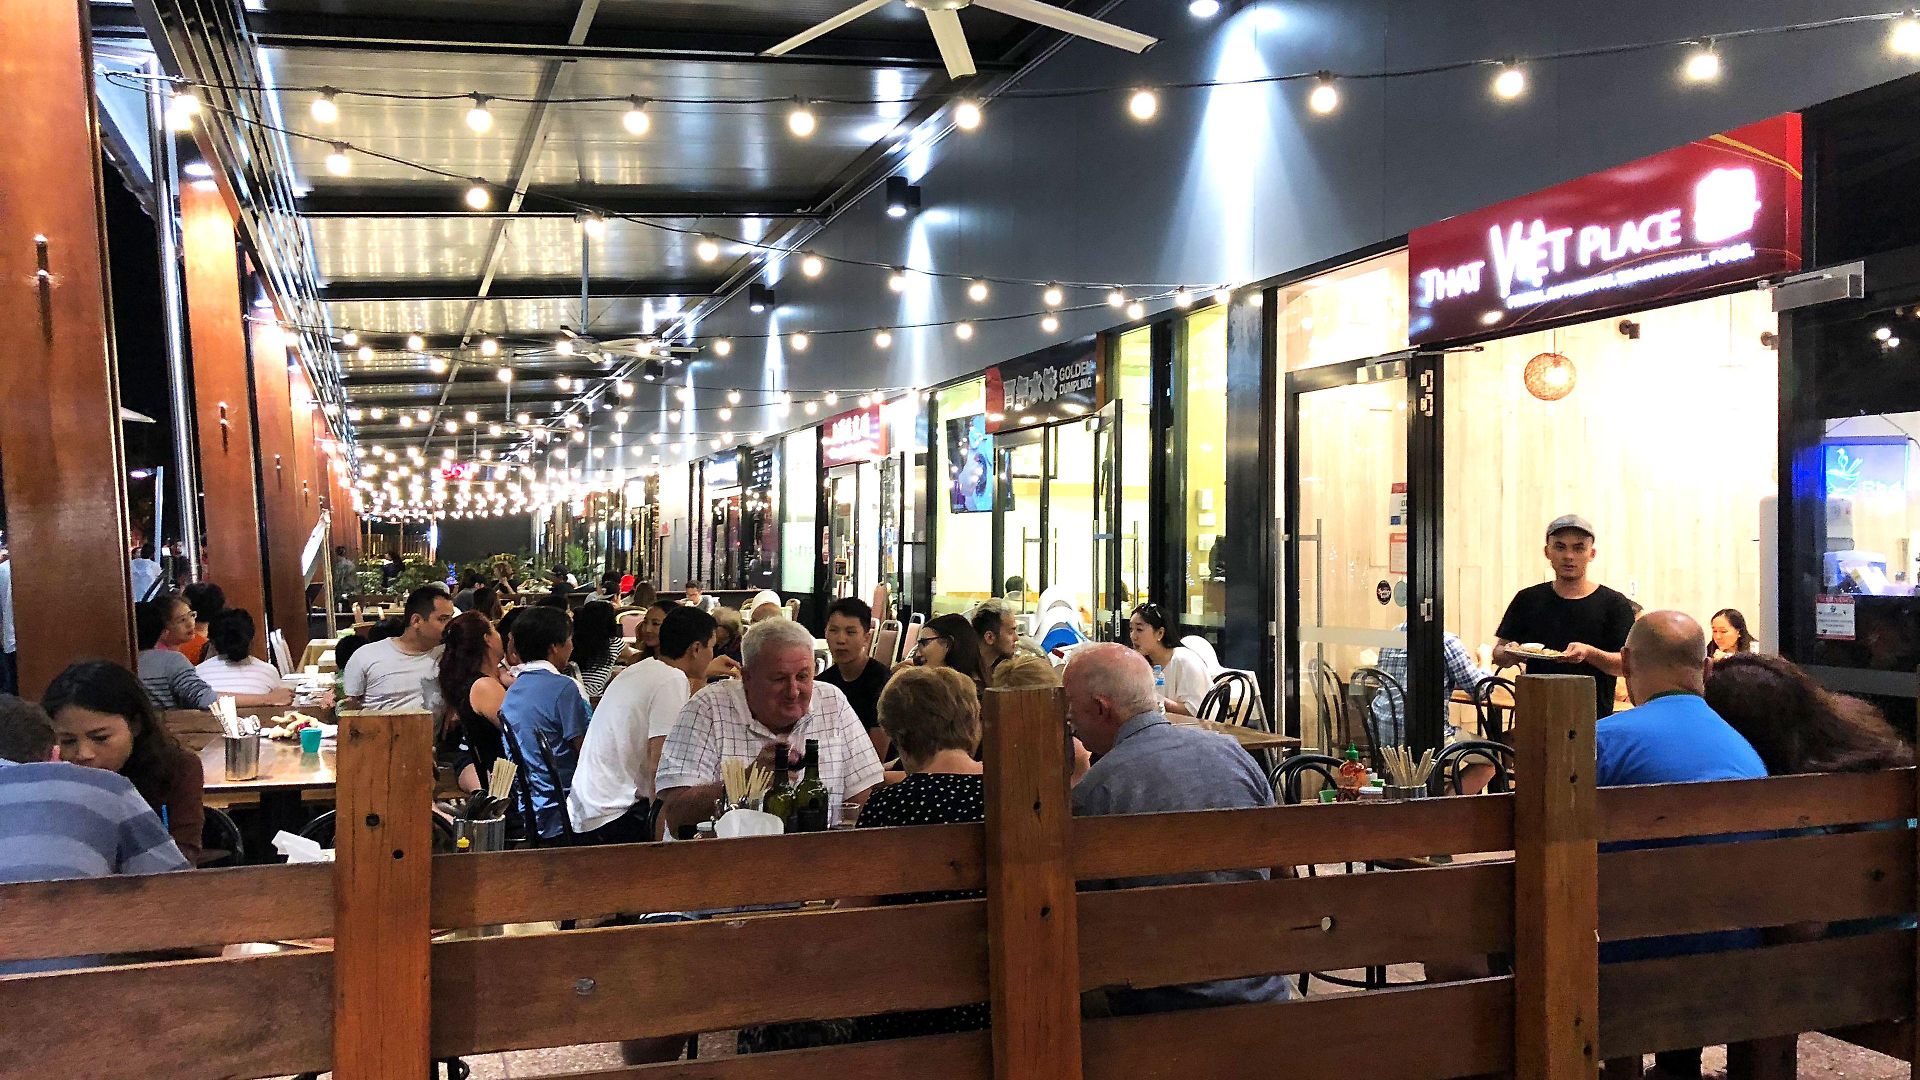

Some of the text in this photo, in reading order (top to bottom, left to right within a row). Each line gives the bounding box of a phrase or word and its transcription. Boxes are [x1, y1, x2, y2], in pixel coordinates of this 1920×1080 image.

[1419, 259, 1486, 303] THAT
[1578, 208, 1682, 267] PLACE
[1058, 360, 1096, 382] GOLDEN
[1059, 377, 1093, 395] DUMPLING
